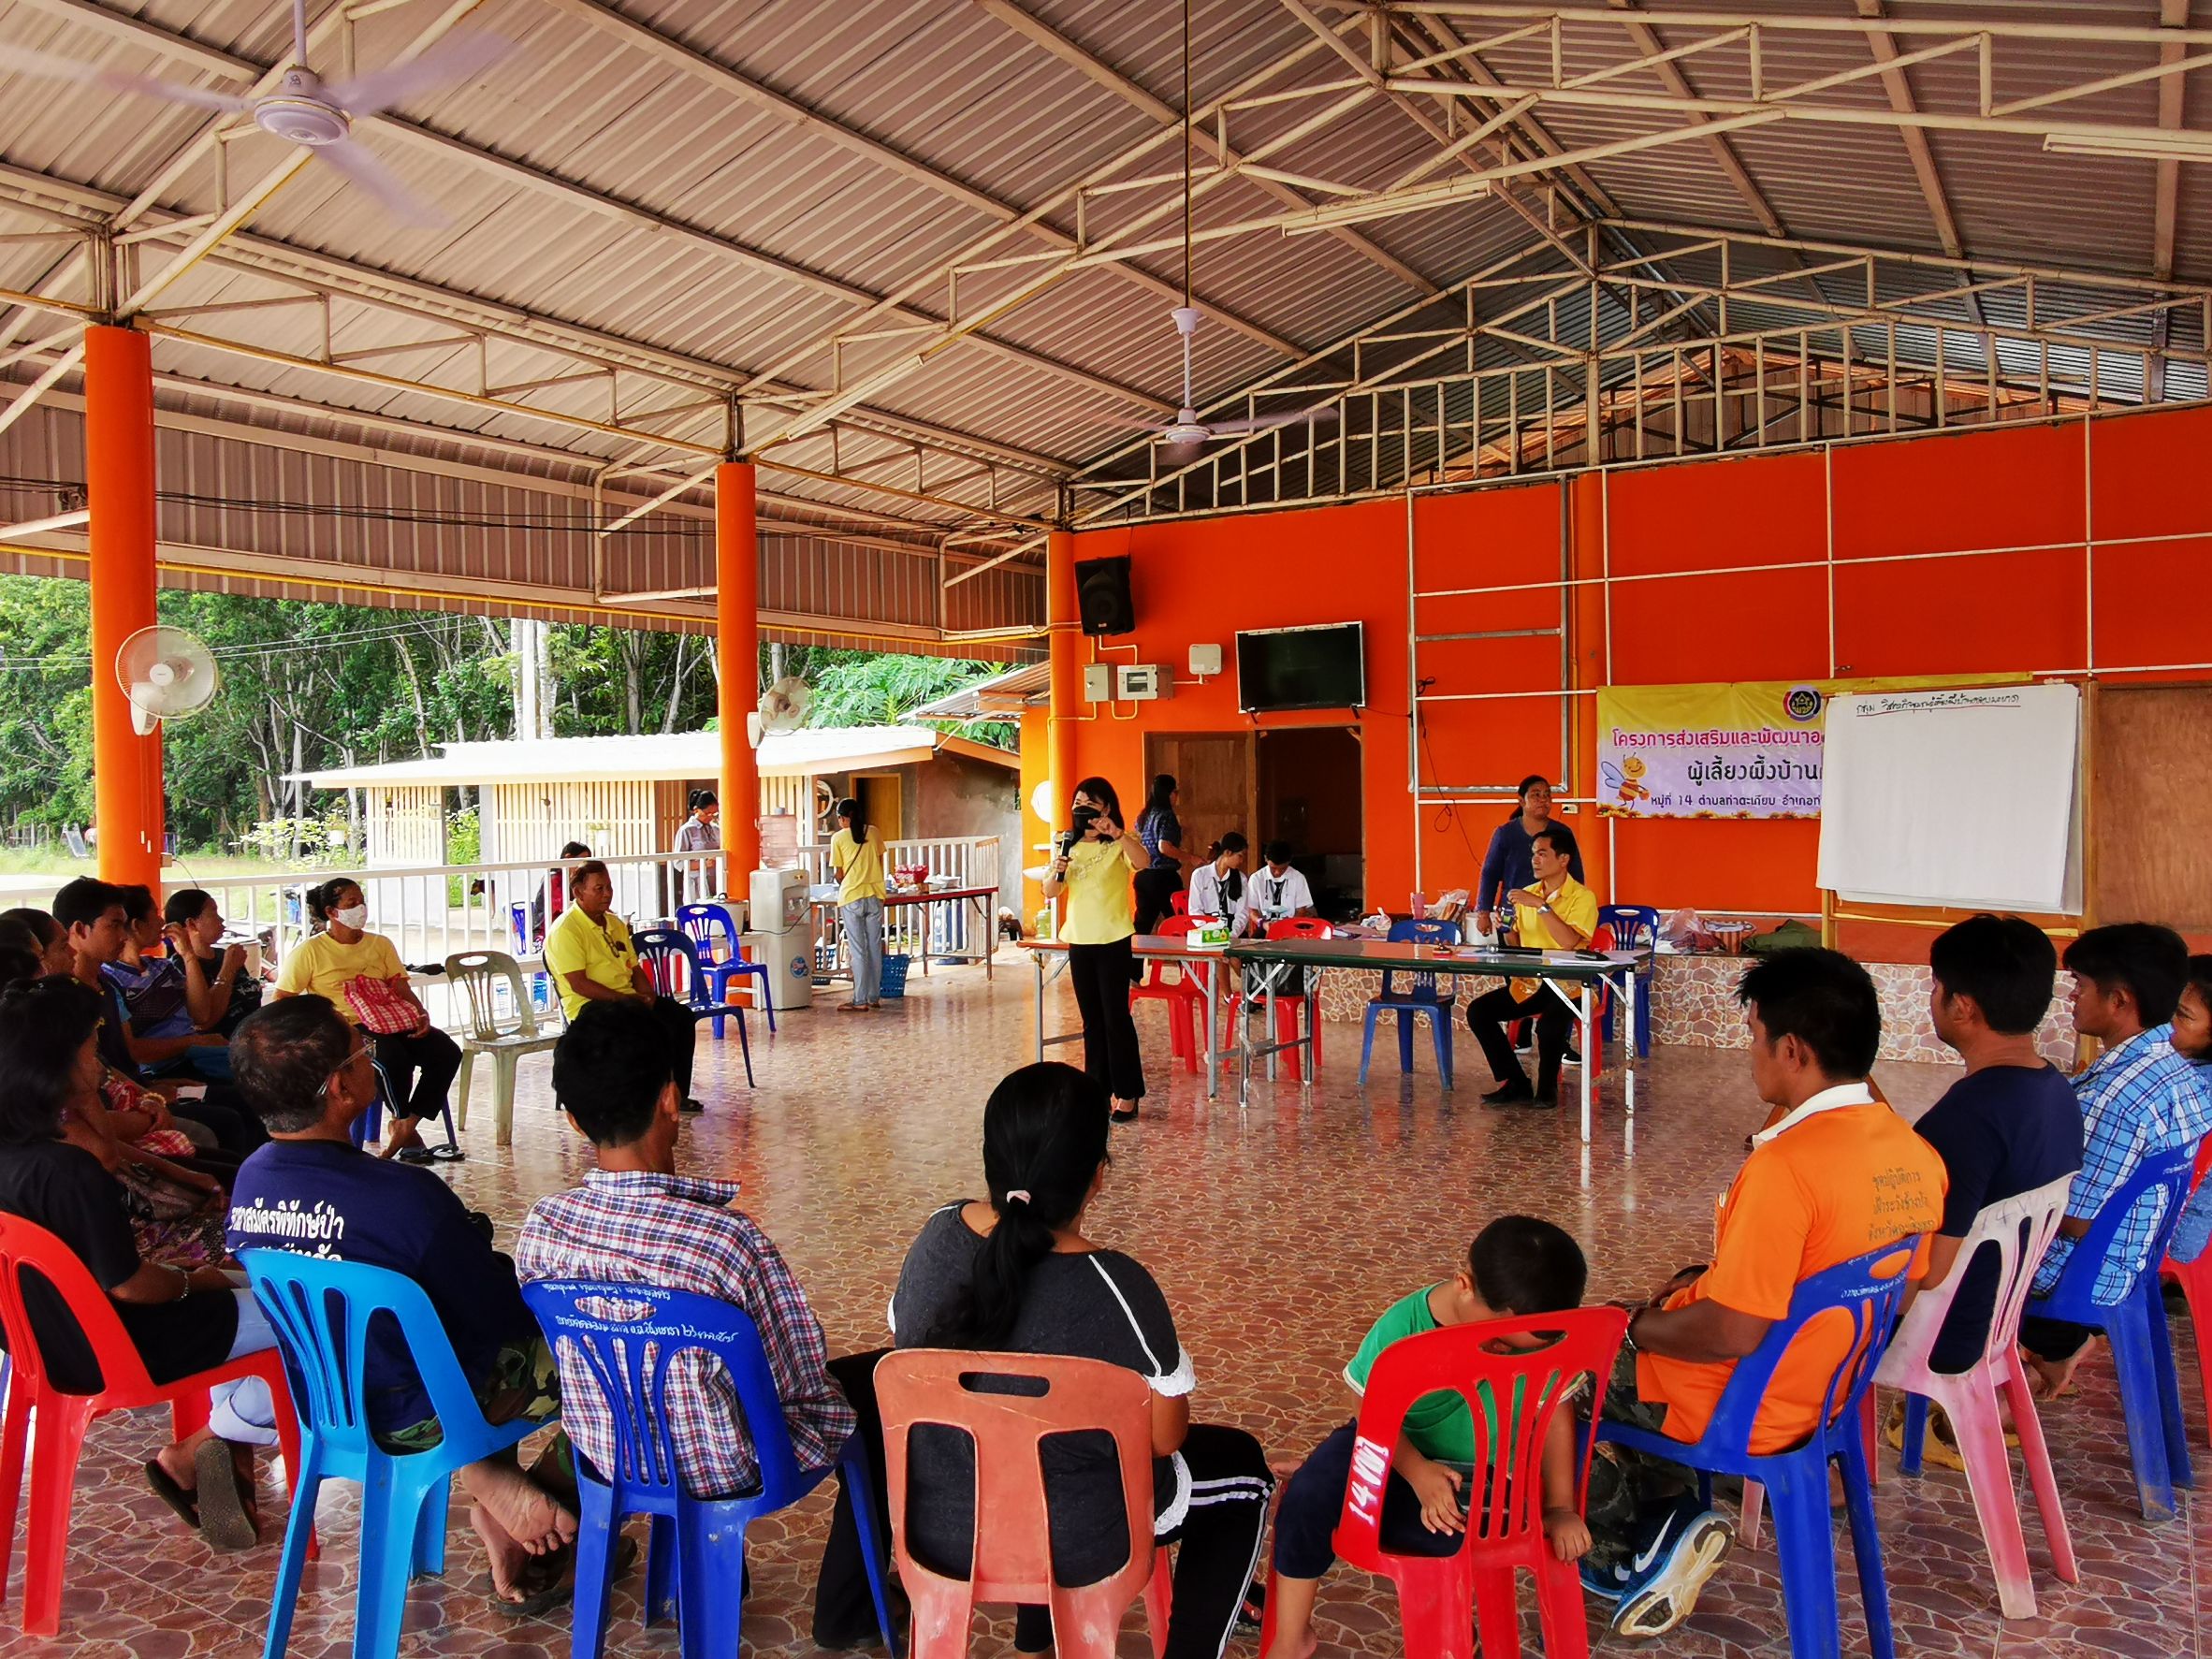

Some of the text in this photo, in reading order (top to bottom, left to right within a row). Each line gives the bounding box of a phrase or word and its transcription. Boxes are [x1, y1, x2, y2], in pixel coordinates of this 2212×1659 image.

[1687, 754, 1822, 786] ผู้เลี้ยงผึ้งบ้าน
[1651, 793, 1672, 809] หมู่ที่
[1679, 794, 1693, 806] 14
